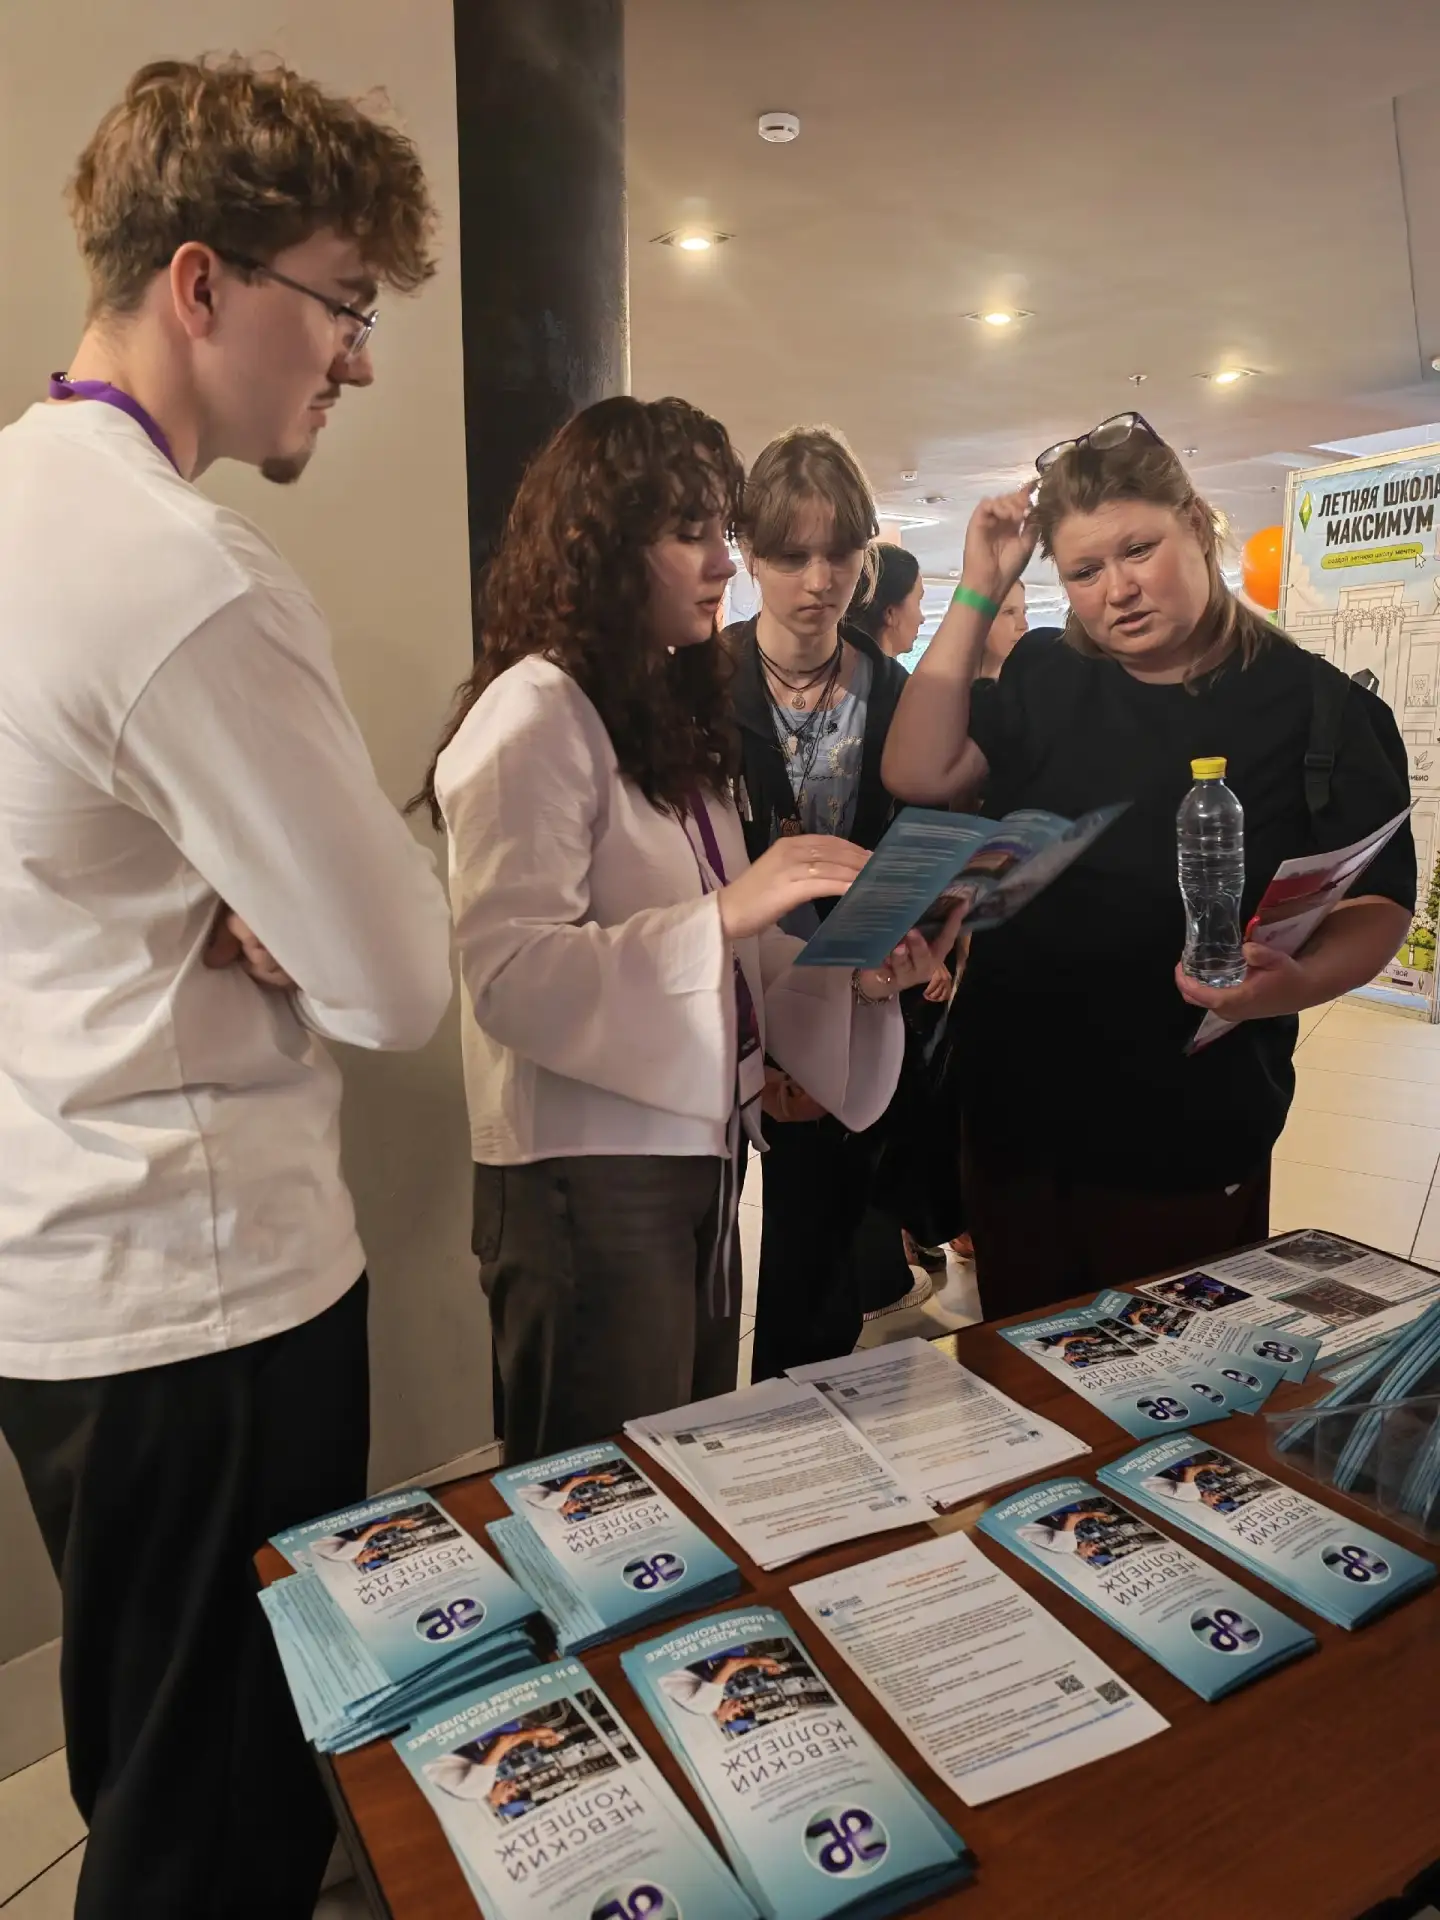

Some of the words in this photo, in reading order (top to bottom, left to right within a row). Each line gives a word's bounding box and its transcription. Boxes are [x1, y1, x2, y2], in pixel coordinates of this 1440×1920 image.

[1318, 485, 1379, 518] ЛЕТНЯЯ
[1326, 504, 1434, 546] МАКСИМУМ
[1395, 547, 1416, 556] мечты
[1074, 1361, 1148, 1383] КОЛЛЕДЖ
[1082, 1368, 1158, 1391] НЕВСКИЙ
[562, 1504, 662, 1544] КОЛЛЕДЖ
[569, 1511, 669, 1555] НЕВСКИЙ
[1230, 1496, 1302, 1537] КОЛЛЕДЖ
[1245, 1504, 1318, 1546] НЕВСКИЙ
[354, 1546, 466, 1597] КОЛЛЕДЖ
[361, 1554, 474, 1606] НЕВСКИЙ
[1099, 1550, 1186, 1594] КОЛЛЕДЖ
[1113, 1561, 1200, 1606] НЕВСКИЙ
[700, 1630, 739, 1649] ЖДЕМ
[719, 1616, 765, 1631] НАШЕМ
[742, 1624, 763, 1636] МЫ
[645, 1626, 718, 1662] КОЛЛЕДЖЕ
[670, 1643, 699, 1661] ВАС
[488, 1678, 541, 1706] НАШЕМ
[513, 1690, 538, 1706] МЫ
[406, 1702, 488, 1751] КОЛЛЕДЖЕ
[435, 1723, 467, 1747] ВАС
[468, 1702, 512, 1728] ЖДЕМ
[721, 1719, 848, 1776] КОЛЛЕДЖ
[730, 1736, 859, 1795] НЕВСКИЙ
[494, 1785, 632, 1864] КОЛЛЕДЖ
[507, 1801, 645, 1884] НЕВСКИЙ
